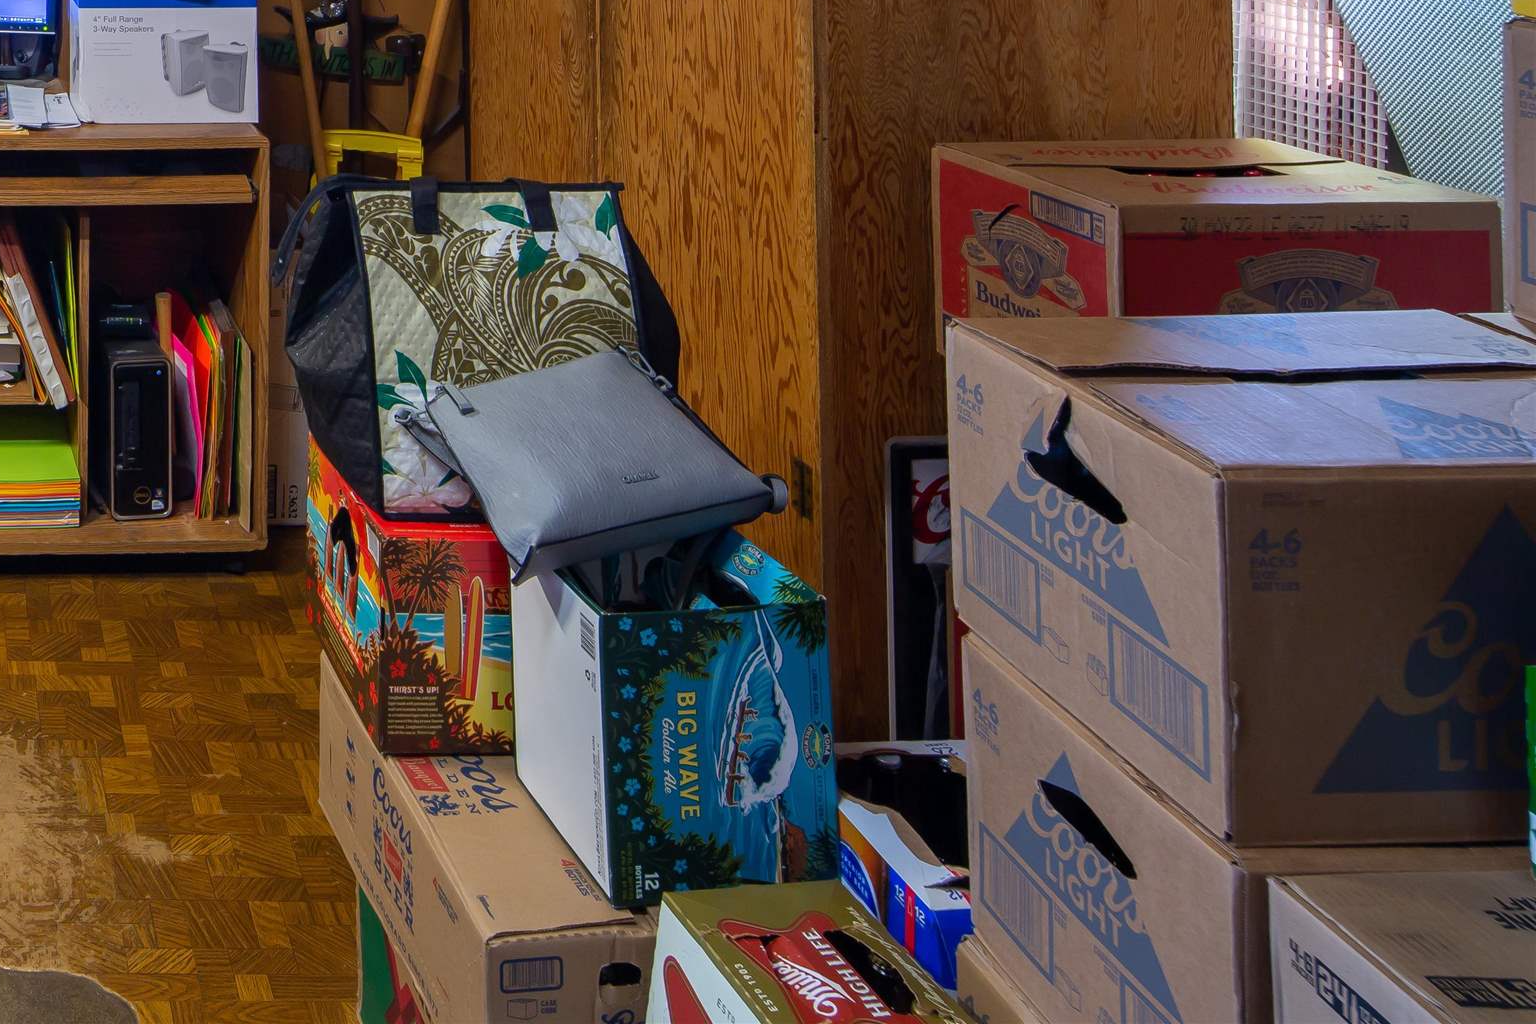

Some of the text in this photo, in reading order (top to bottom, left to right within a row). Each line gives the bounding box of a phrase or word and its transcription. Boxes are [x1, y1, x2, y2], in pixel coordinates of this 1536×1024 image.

[93, 26, 154, 34] 3-Way Speakers
[120, 16, 144, 24] Range
[975, 283, 1042, 317] Budwei
[956, 373, 984, 406] 4-6
[288, 484, 299, 520] G3632
[1030, 511, 1110, 590] LIGHT
[1248, 528, 1302, 554] 4-6
[1249, 556, 1296, 568] PACKS
[388, 686, 440, 694] THIRST'S UP!
[972, 688, 999, 726] 4-6
[661, 717, 678, 795] Golden Ale
[676, 690, 702, 822] BIG WAVE
[822, 729, 832, 759] KONA
[634, 865, 643, 900] BOTTLES
[644, 872, 660, 891] 12
[894, 884, 904, 902] 12
[1044, 847, 1120, 948] LIGHT
[914, 906, 926, 924] 12
[802, 928, 892, 1018] LIFE HIGH
[1290, 938, 1313, 974] 4-6
[772, 952, 854, 1017] Miller
